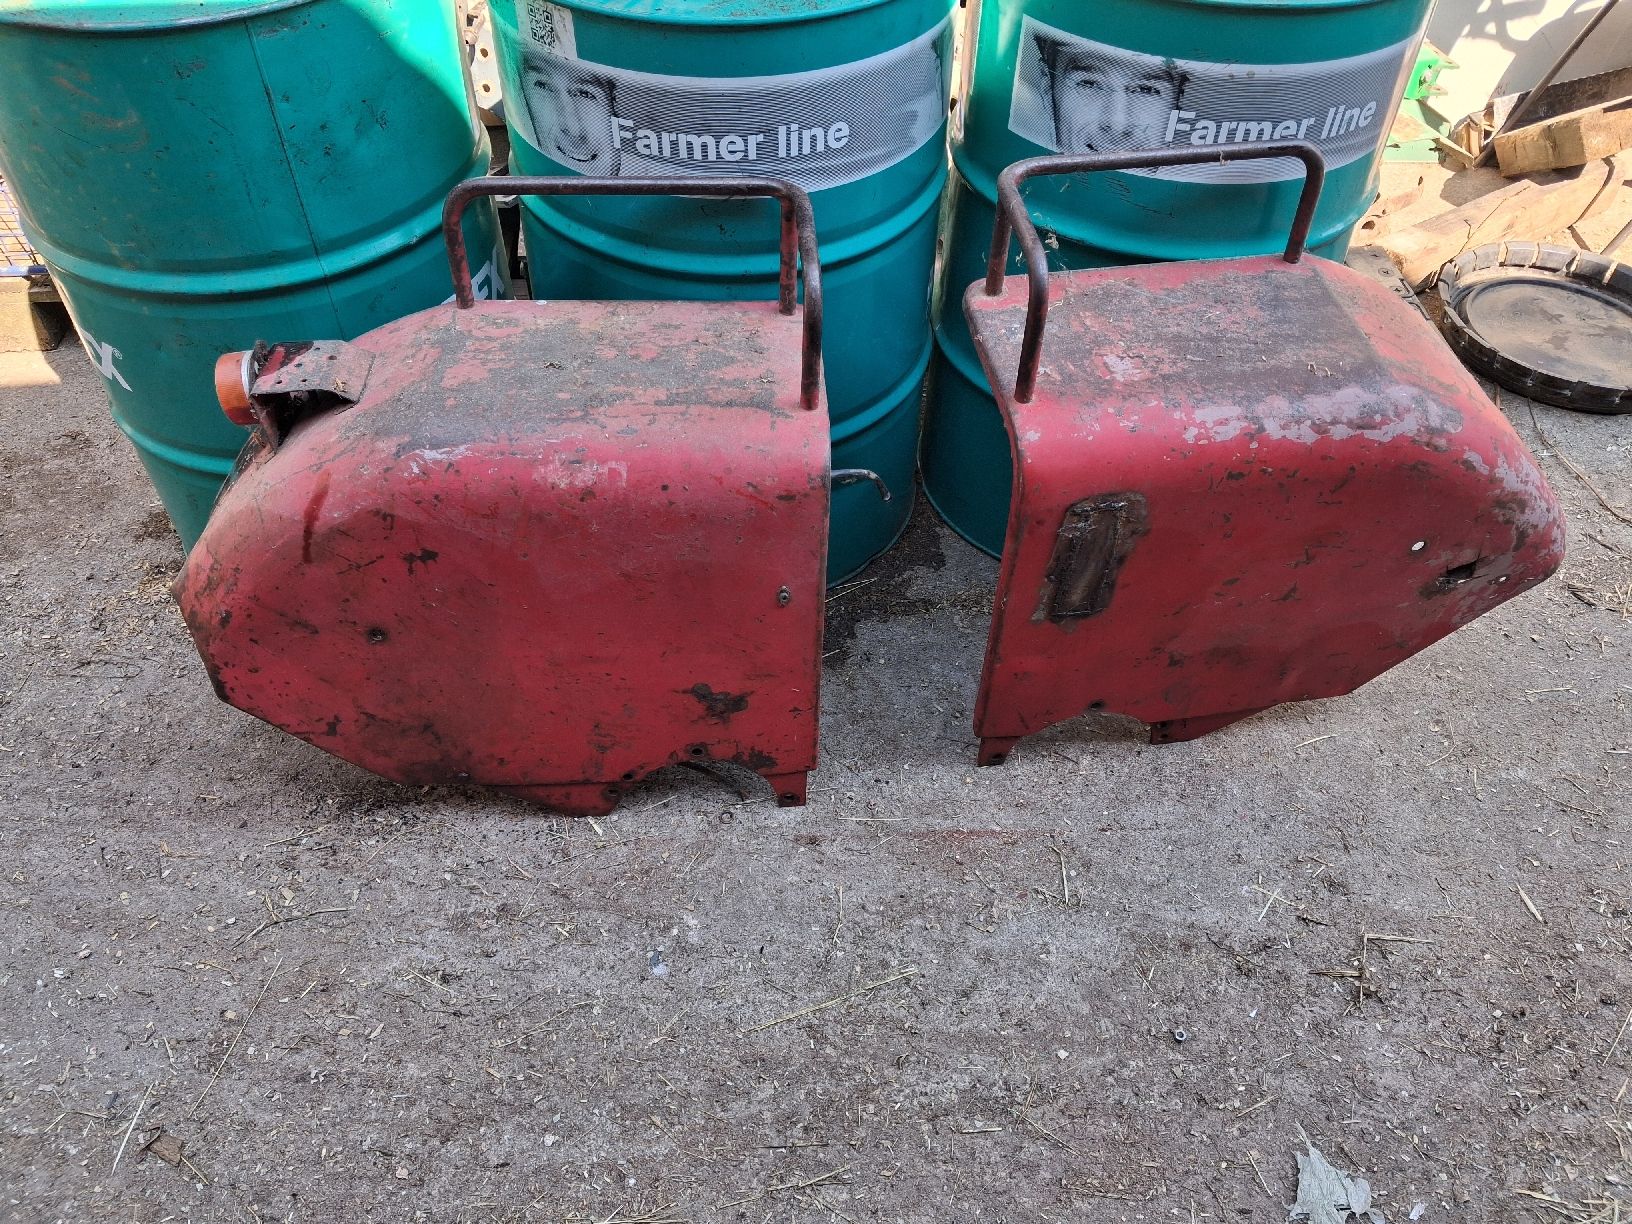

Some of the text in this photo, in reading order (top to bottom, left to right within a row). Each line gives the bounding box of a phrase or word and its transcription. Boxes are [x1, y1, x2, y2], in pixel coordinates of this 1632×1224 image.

[610, 115, 850, 162] Farmer line
[1164, 100, 1377, 146] Farmer line
